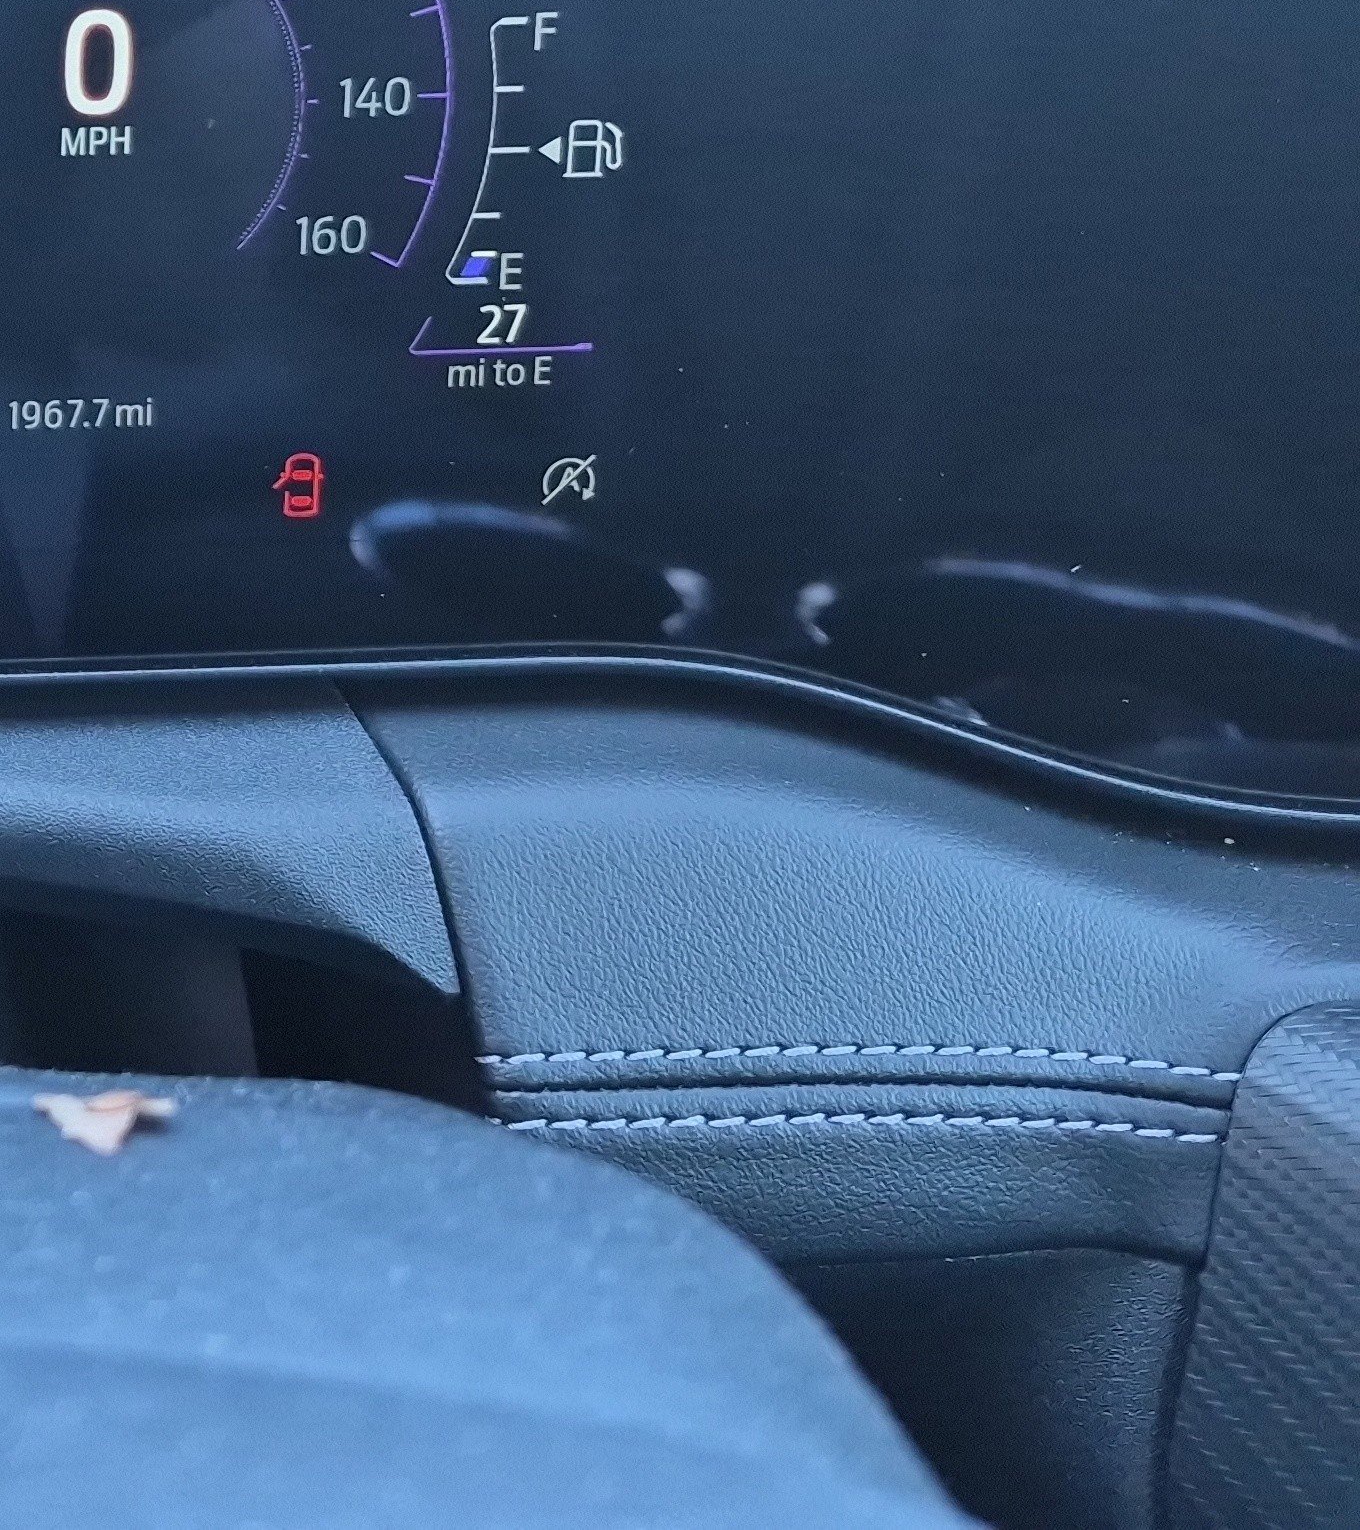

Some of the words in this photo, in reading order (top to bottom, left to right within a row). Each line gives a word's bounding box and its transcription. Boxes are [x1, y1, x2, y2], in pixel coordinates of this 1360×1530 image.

[533, 11, 559, 51] F
[64, 8, 132, 116] 0
[339, 76, 412, 118] 140
[60, 125, 132, 157] MPH
[296, 215, 367, 255] 160
[499, 252, 524, 291] E
[476, 303, 527, 344] 27
[447, 357, 486, 388] mi
[493, 359, 526, 387] to
[533, 355, 553, 385] E
